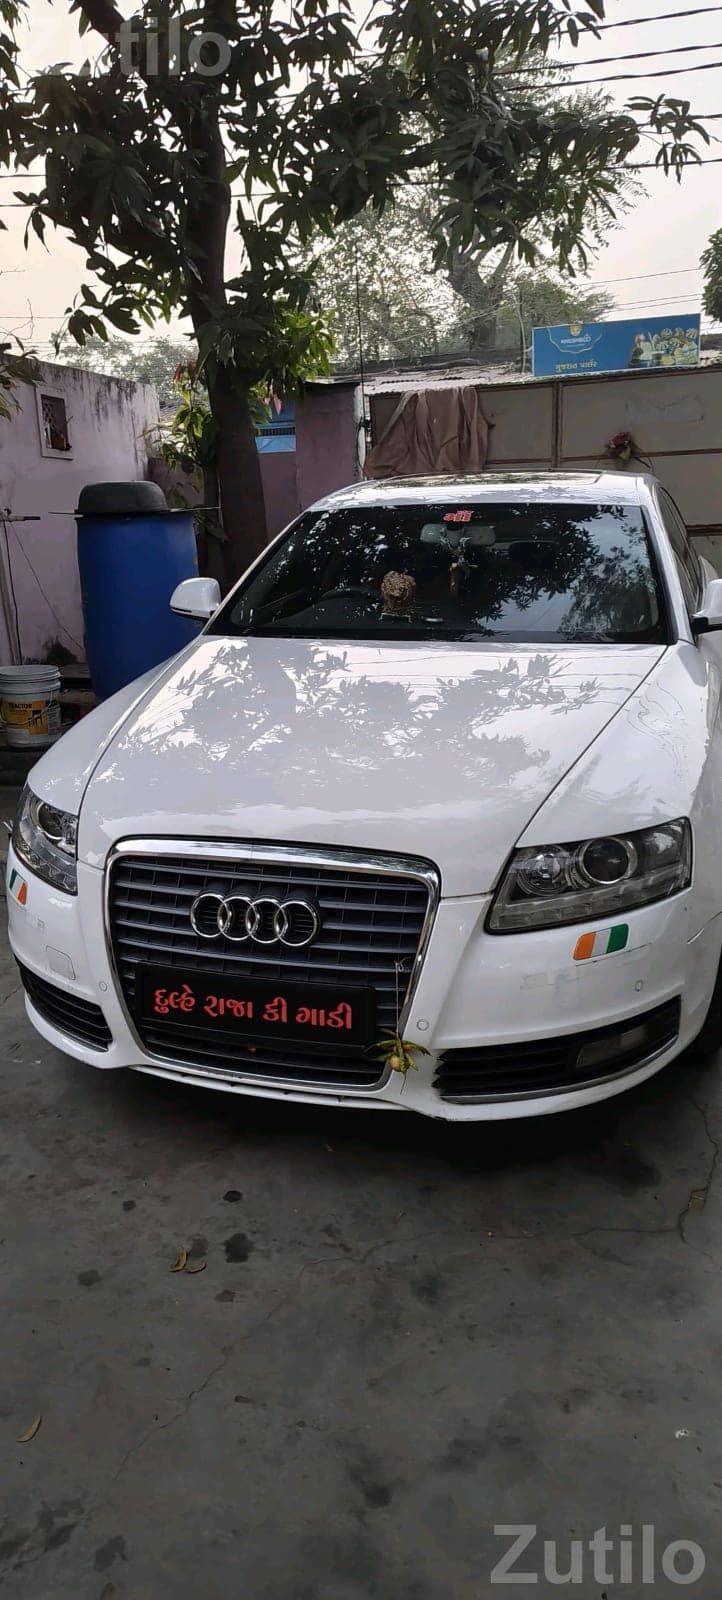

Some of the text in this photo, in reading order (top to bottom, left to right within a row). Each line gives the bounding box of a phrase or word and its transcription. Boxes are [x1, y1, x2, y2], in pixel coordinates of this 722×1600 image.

[154, 983, 353, 1030] દુલ્હે રાજા કી ગાડી
